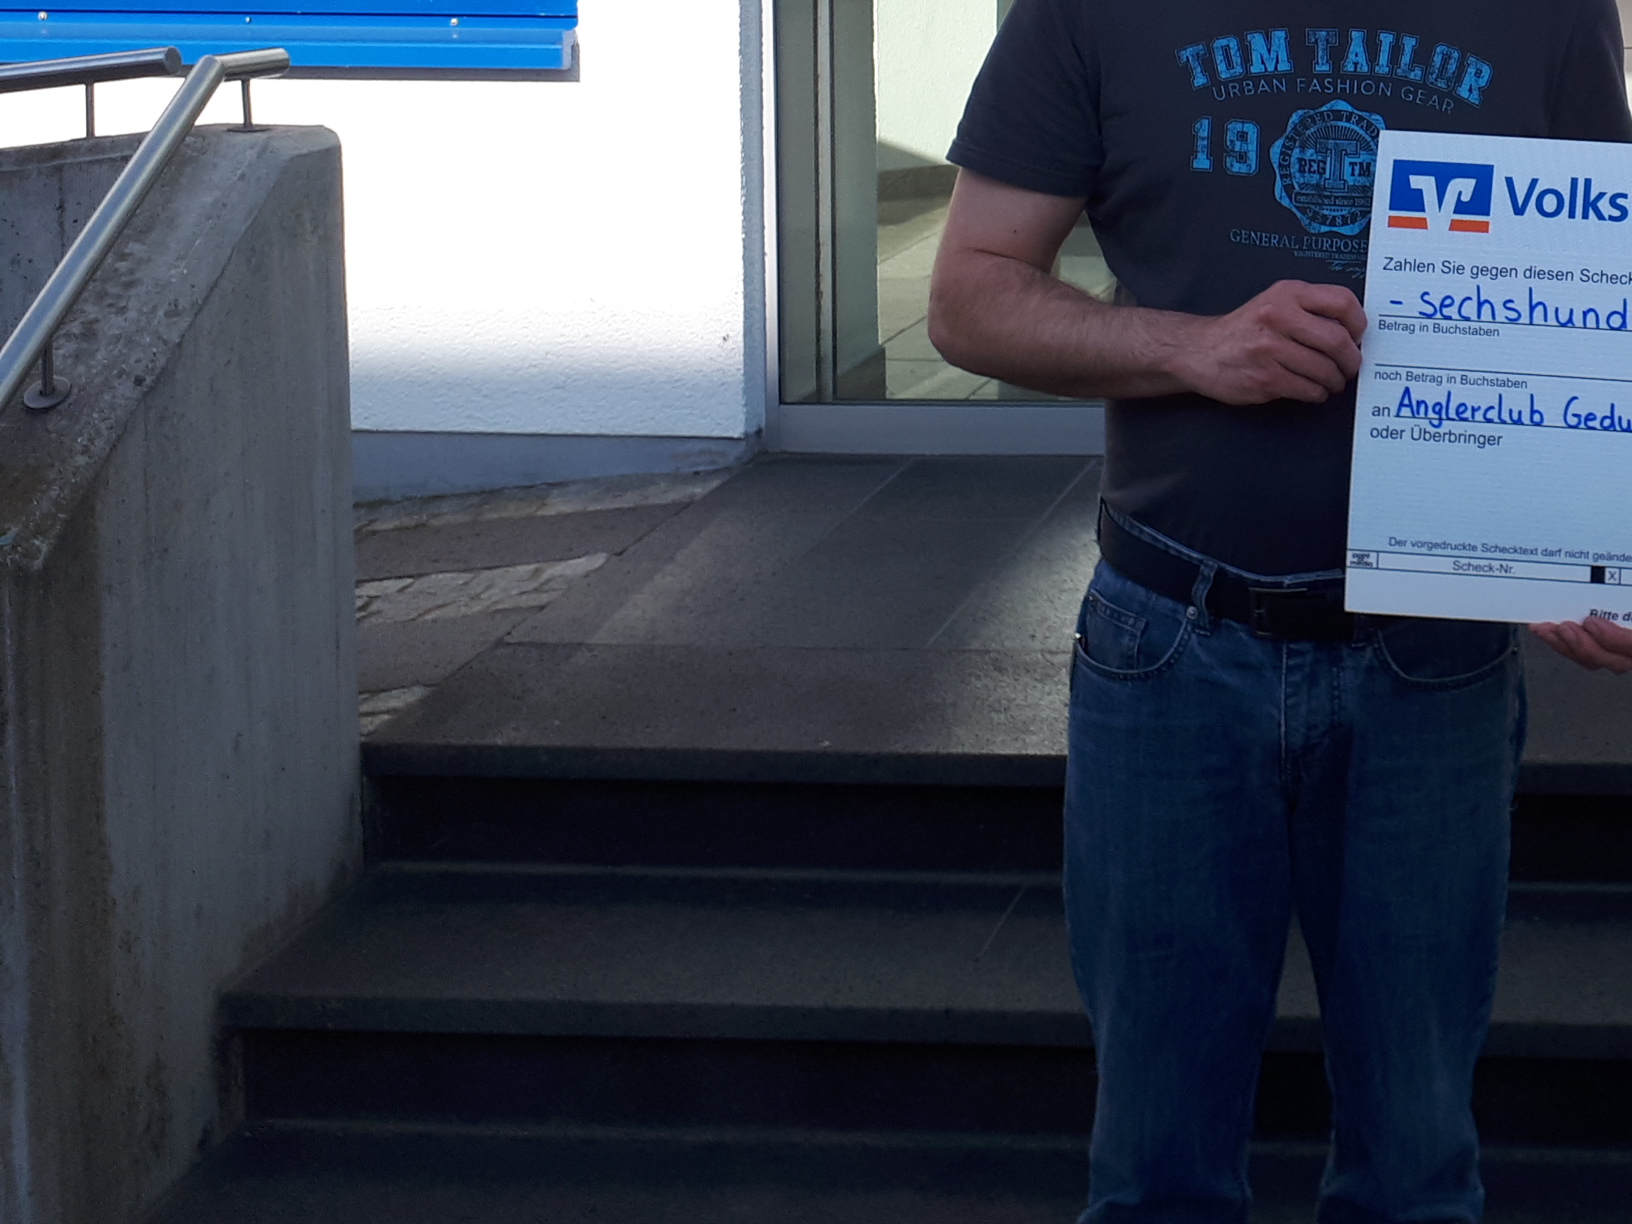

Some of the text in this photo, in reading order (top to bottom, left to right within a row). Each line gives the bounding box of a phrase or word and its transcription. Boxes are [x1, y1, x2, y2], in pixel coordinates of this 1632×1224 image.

[1175, 28, 1493, 108] TOM TAILOR
[1212, 78, 1455, 114] URBAN FASHION GEAR
[1280, 111, 1333, 185] REGISTERED
[1298, 158, 1327, 174] REG
[1230, 229, 1299, 249] GENERAL
[1383, 257, 1436, 274] Zahlen
[1440, 260, 1466, 275] Sie
[1470, 265, 1518, 281] gegen
[1523, 265, 1574, 281] diesen
[1378, 320, 1500, 338] Betrag in Buchstaben
[1374, 370, 1528, 390] noch Betrag in Buchstaben
[1371, 405, 1391, 418] an
[1395, 386, 1545, 428] Anglerclub
[1370, 424, 1503, 448] oder Überbringer
[1388, 537, 1407, 548] Der
[1410, 539, 1478, 554] vorgedruckte
[1481, 543, 1538, 557] Schecktext
[1541, 547, 1562, 558] darf
[1564, 548, 1589, 561] nicht
[1452, 560, 1516, 575] Scheck-Nr.
[1608, 570, 1617, 581] X
